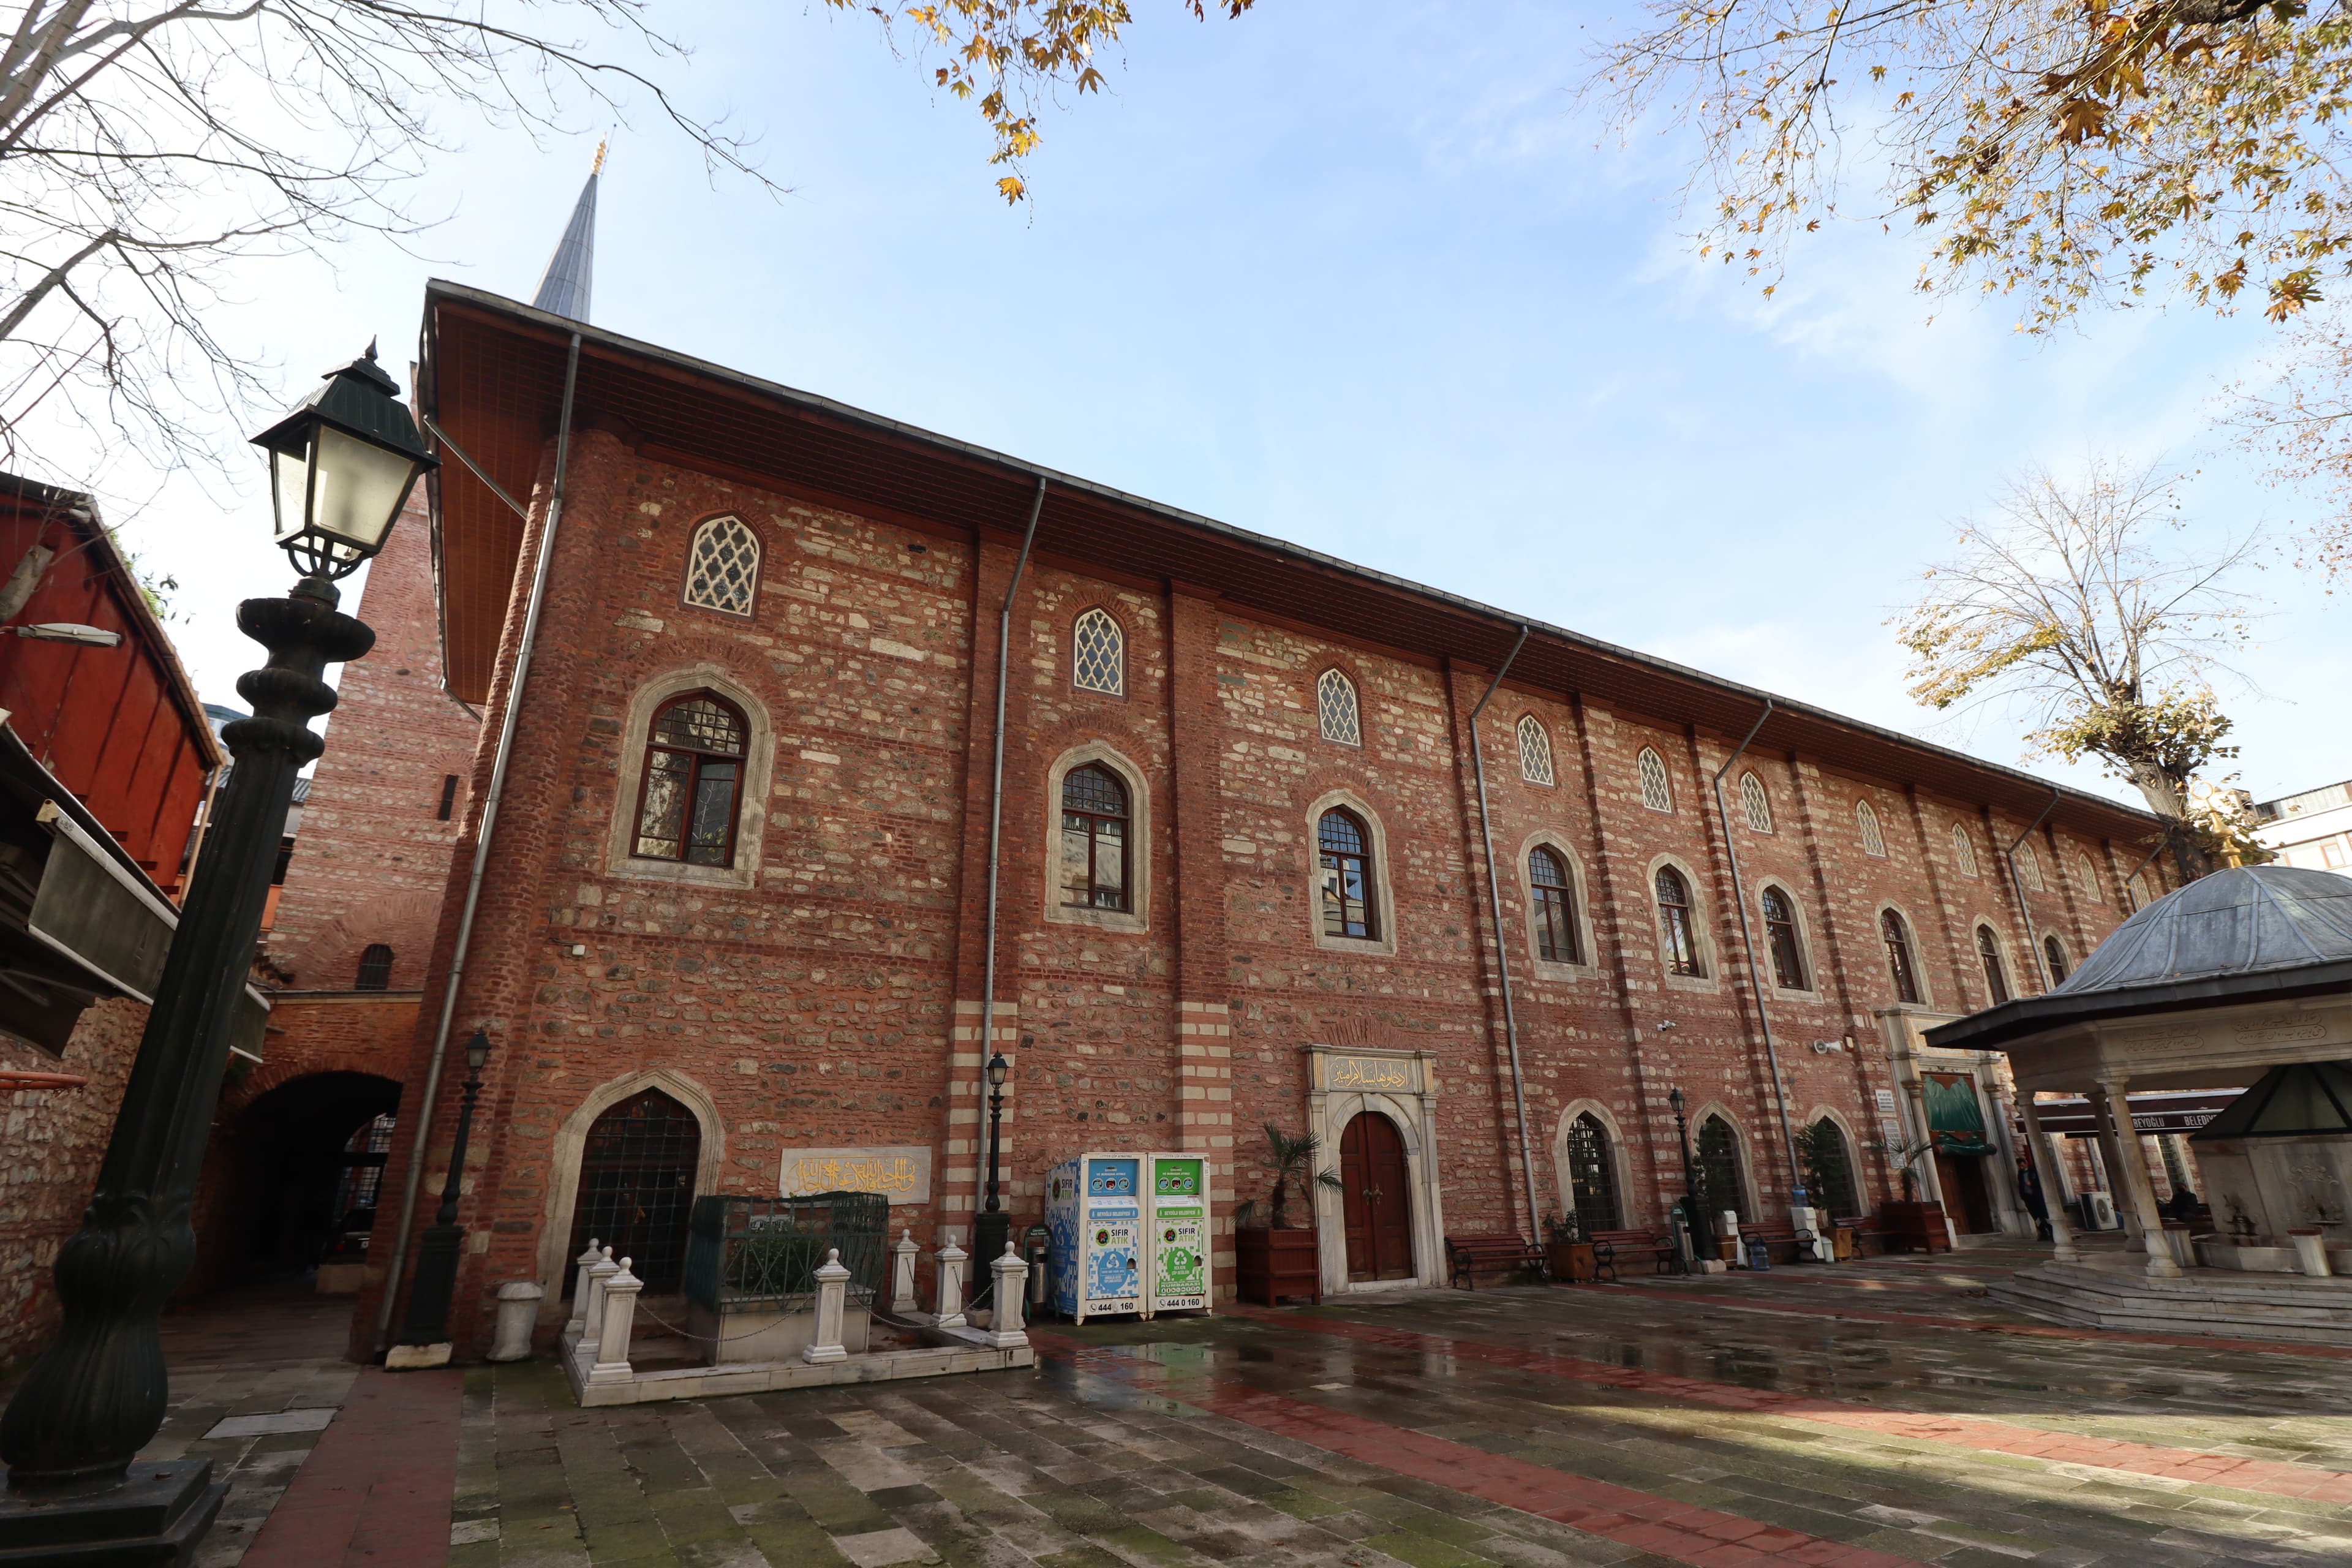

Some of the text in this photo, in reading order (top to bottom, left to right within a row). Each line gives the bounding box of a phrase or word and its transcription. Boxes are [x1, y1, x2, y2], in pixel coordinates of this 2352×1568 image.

[2133, 1117, 2165, 1128] BEYOĞLU
[1061, 1179, 1072, 1189] SIFIR
[1061, 1189, 1072, 1200] ATIK
